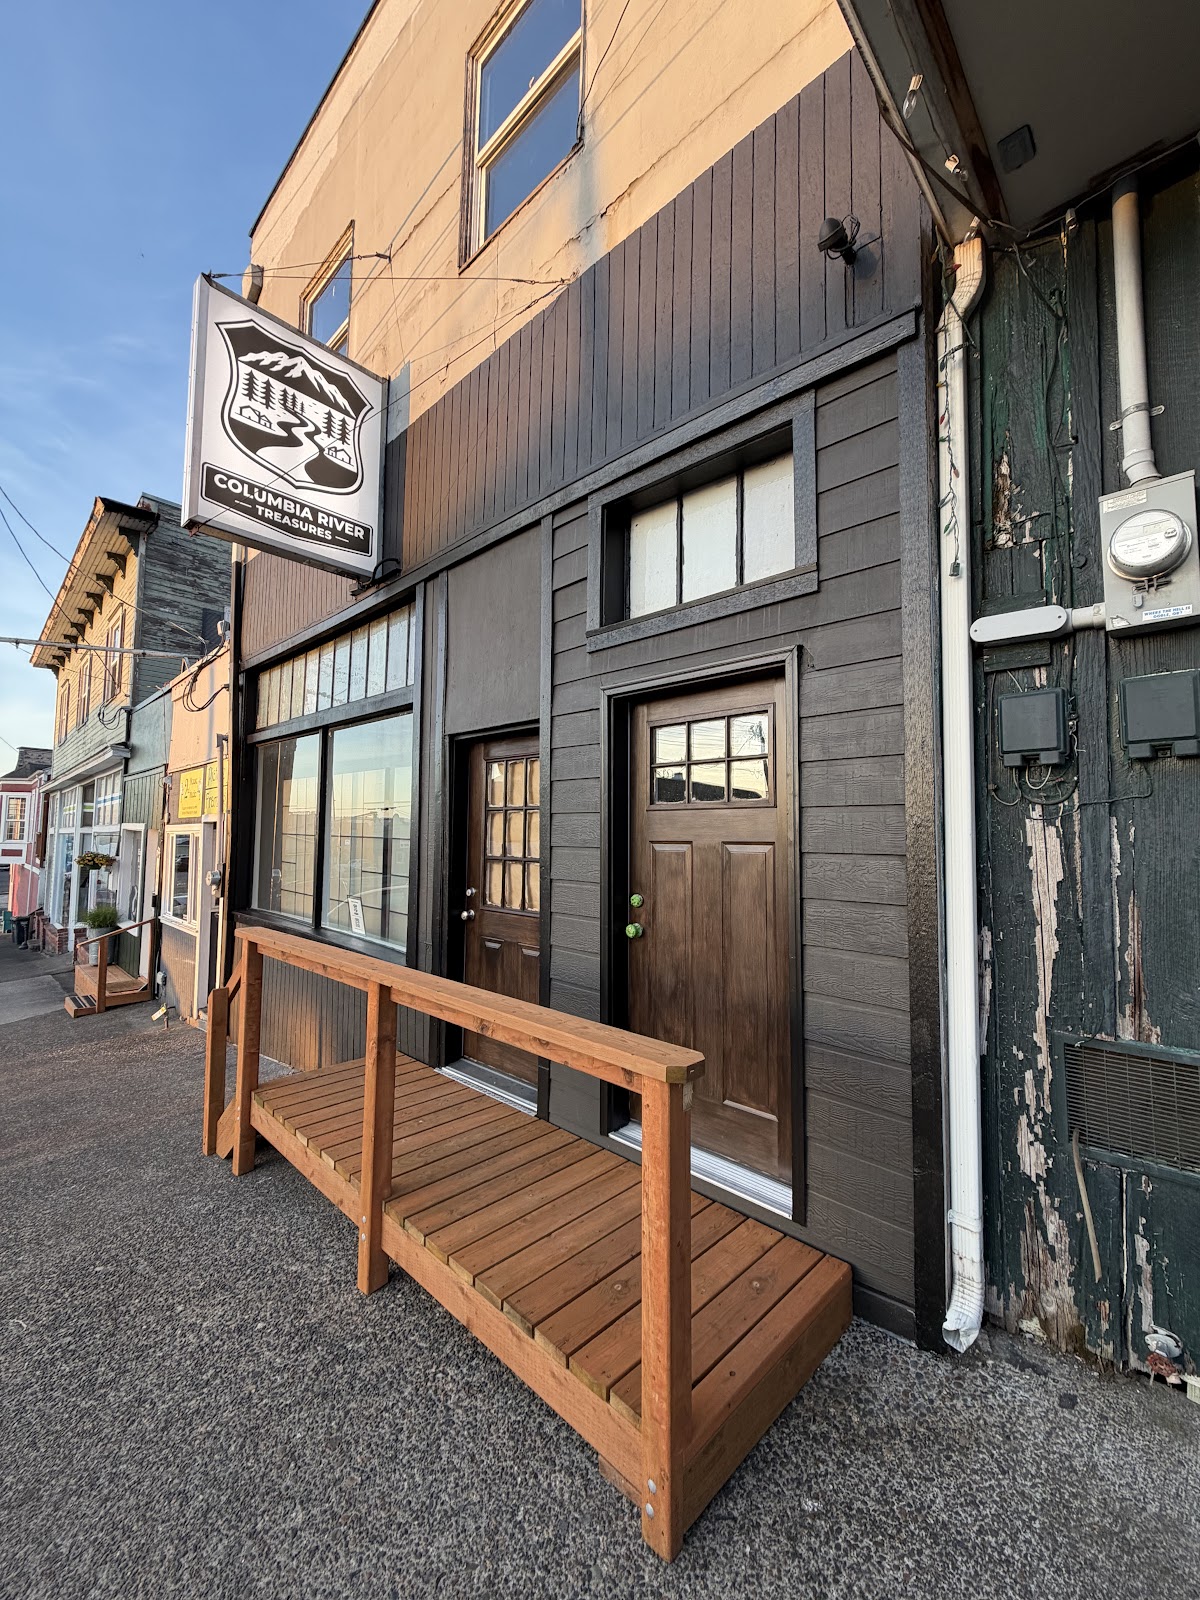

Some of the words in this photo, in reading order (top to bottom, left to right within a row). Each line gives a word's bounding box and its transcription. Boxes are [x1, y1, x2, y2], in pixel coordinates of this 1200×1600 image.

[213, 473, 313, 522] COLUMBIA
[317, 512, 365, 540] RIVER
[256, 504, 333, 540] TREASURES
